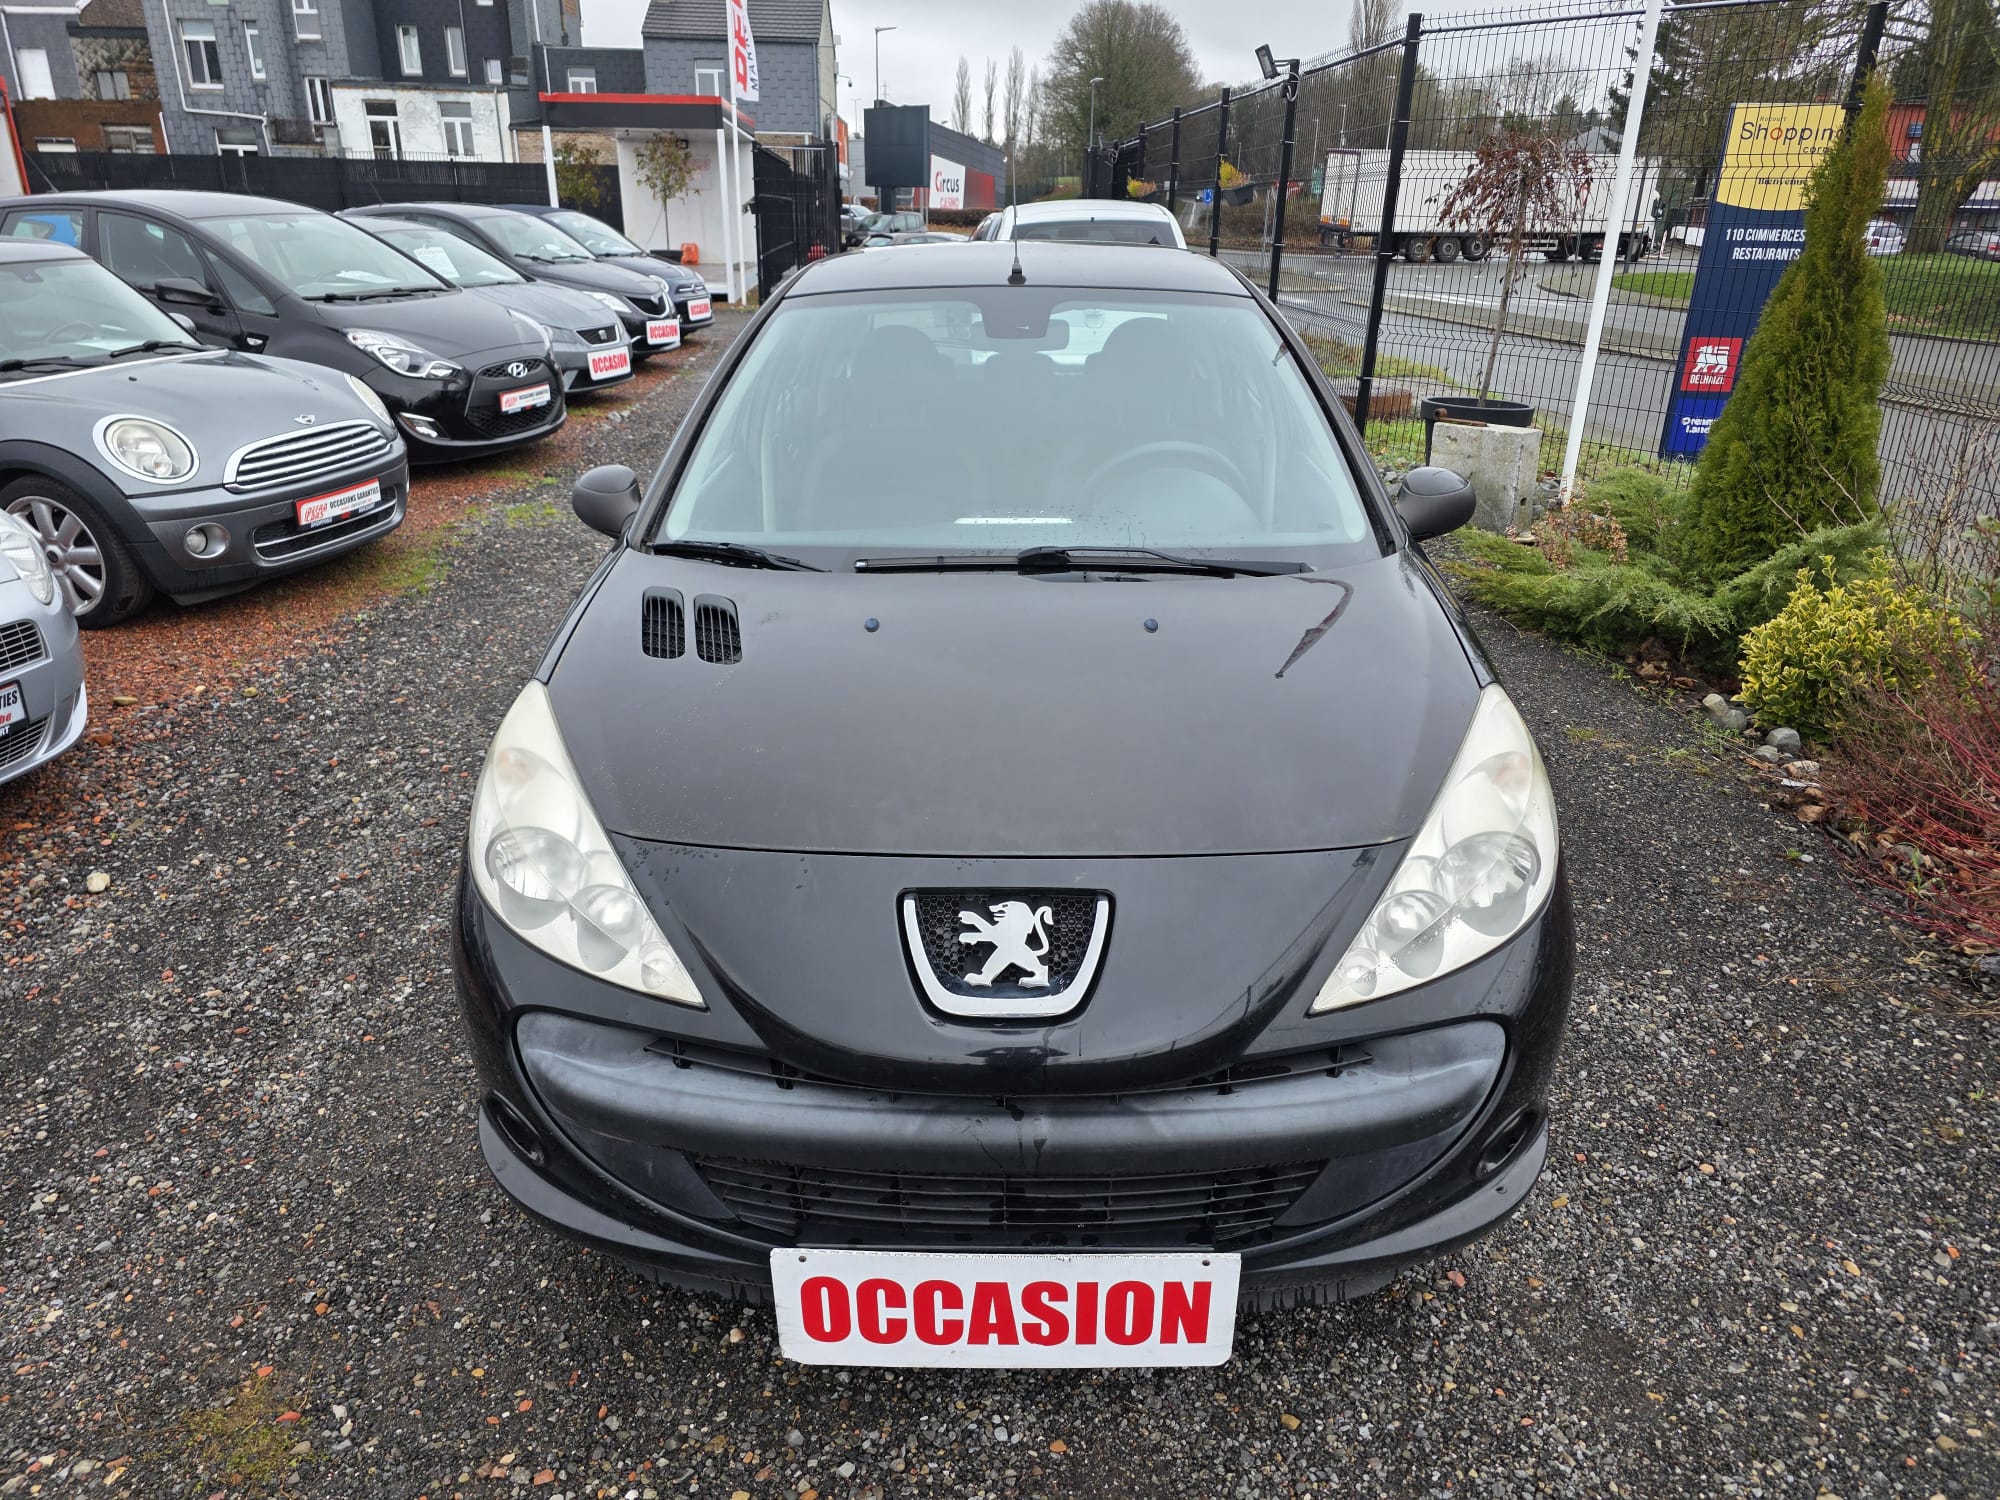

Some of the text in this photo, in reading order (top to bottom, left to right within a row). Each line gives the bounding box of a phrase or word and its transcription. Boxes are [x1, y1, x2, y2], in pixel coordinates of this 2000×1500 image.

[935, 170, 960, 193] Circus
[1726, 228, 1807, 242] 110 COMMERCES
[1732, 247, 1801, 261] RESTAURANTS
[649, 324, 678, 339] OCCASION
[592, 352, 628, 374] OCCASION
[1689, 374, 1726, 385] DELHAIZE
[330, 494, 357, 509] OCCASIONS
[800, 1275, 1212, 1347] OCCASION
